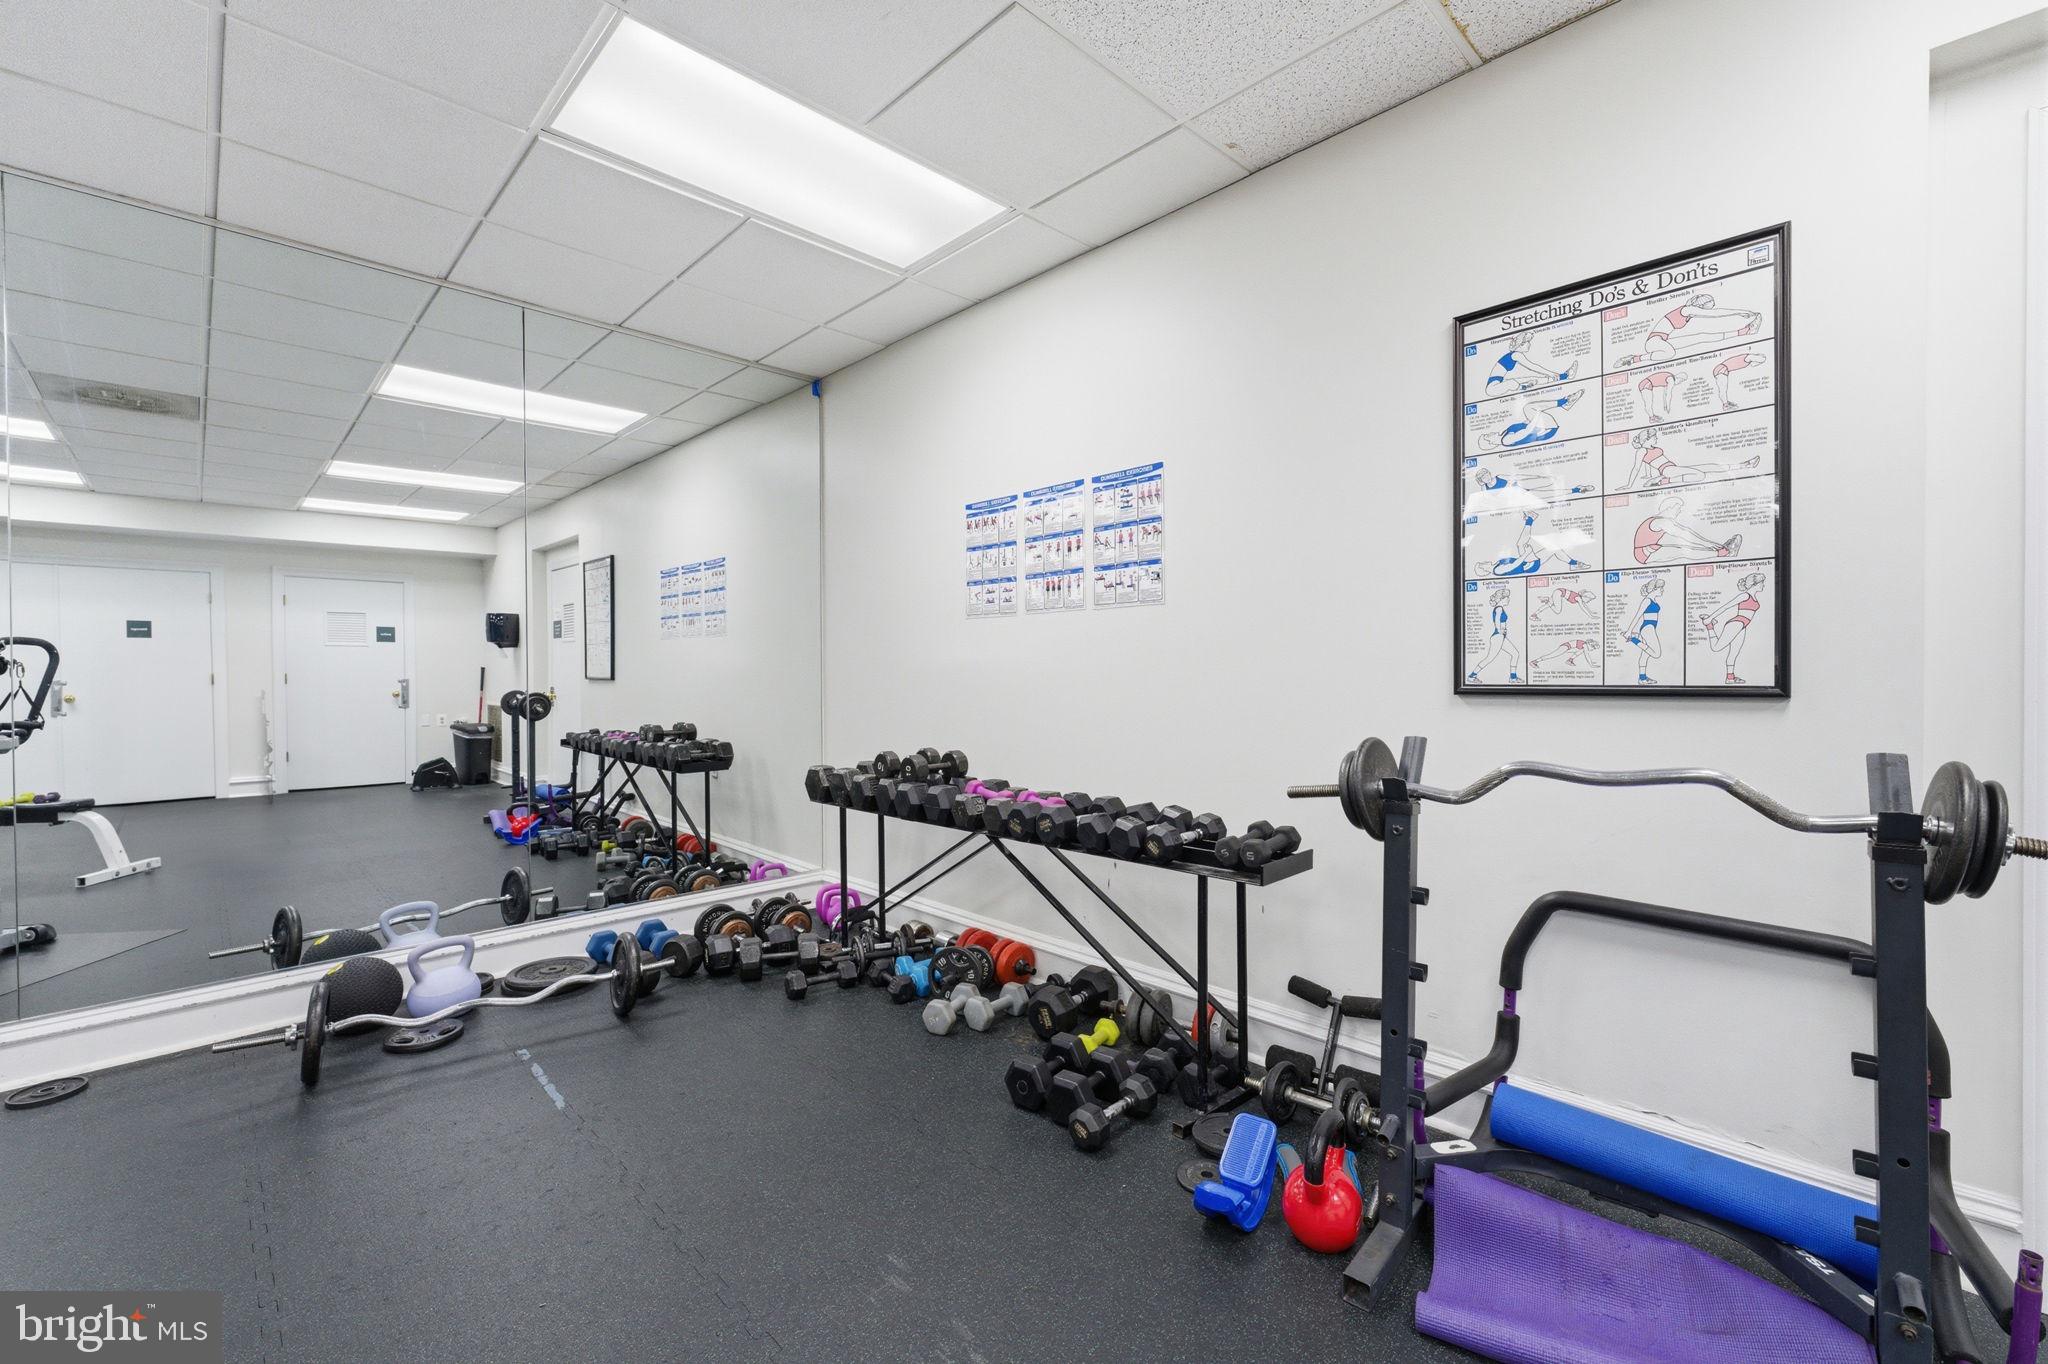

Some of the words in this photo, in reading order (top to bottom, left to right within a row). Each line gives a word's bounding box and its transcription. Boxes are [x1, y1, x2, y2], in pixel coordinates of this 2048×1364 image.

[1501, 300, 1582, 331] Stretching
[1589, 285, 1626, 307] Do's
[1632, 279, 1649, 297] &
[1657, 261, 1718, 290] Don'ts
[1467, 346, 1475, 355] Do
[1467, 405, 1476, 414] Do
[1690, 566, 1711, 576] Don't
[1607, 573, 1618, 582] Do
[1246, 851, 1255, 861] 5
